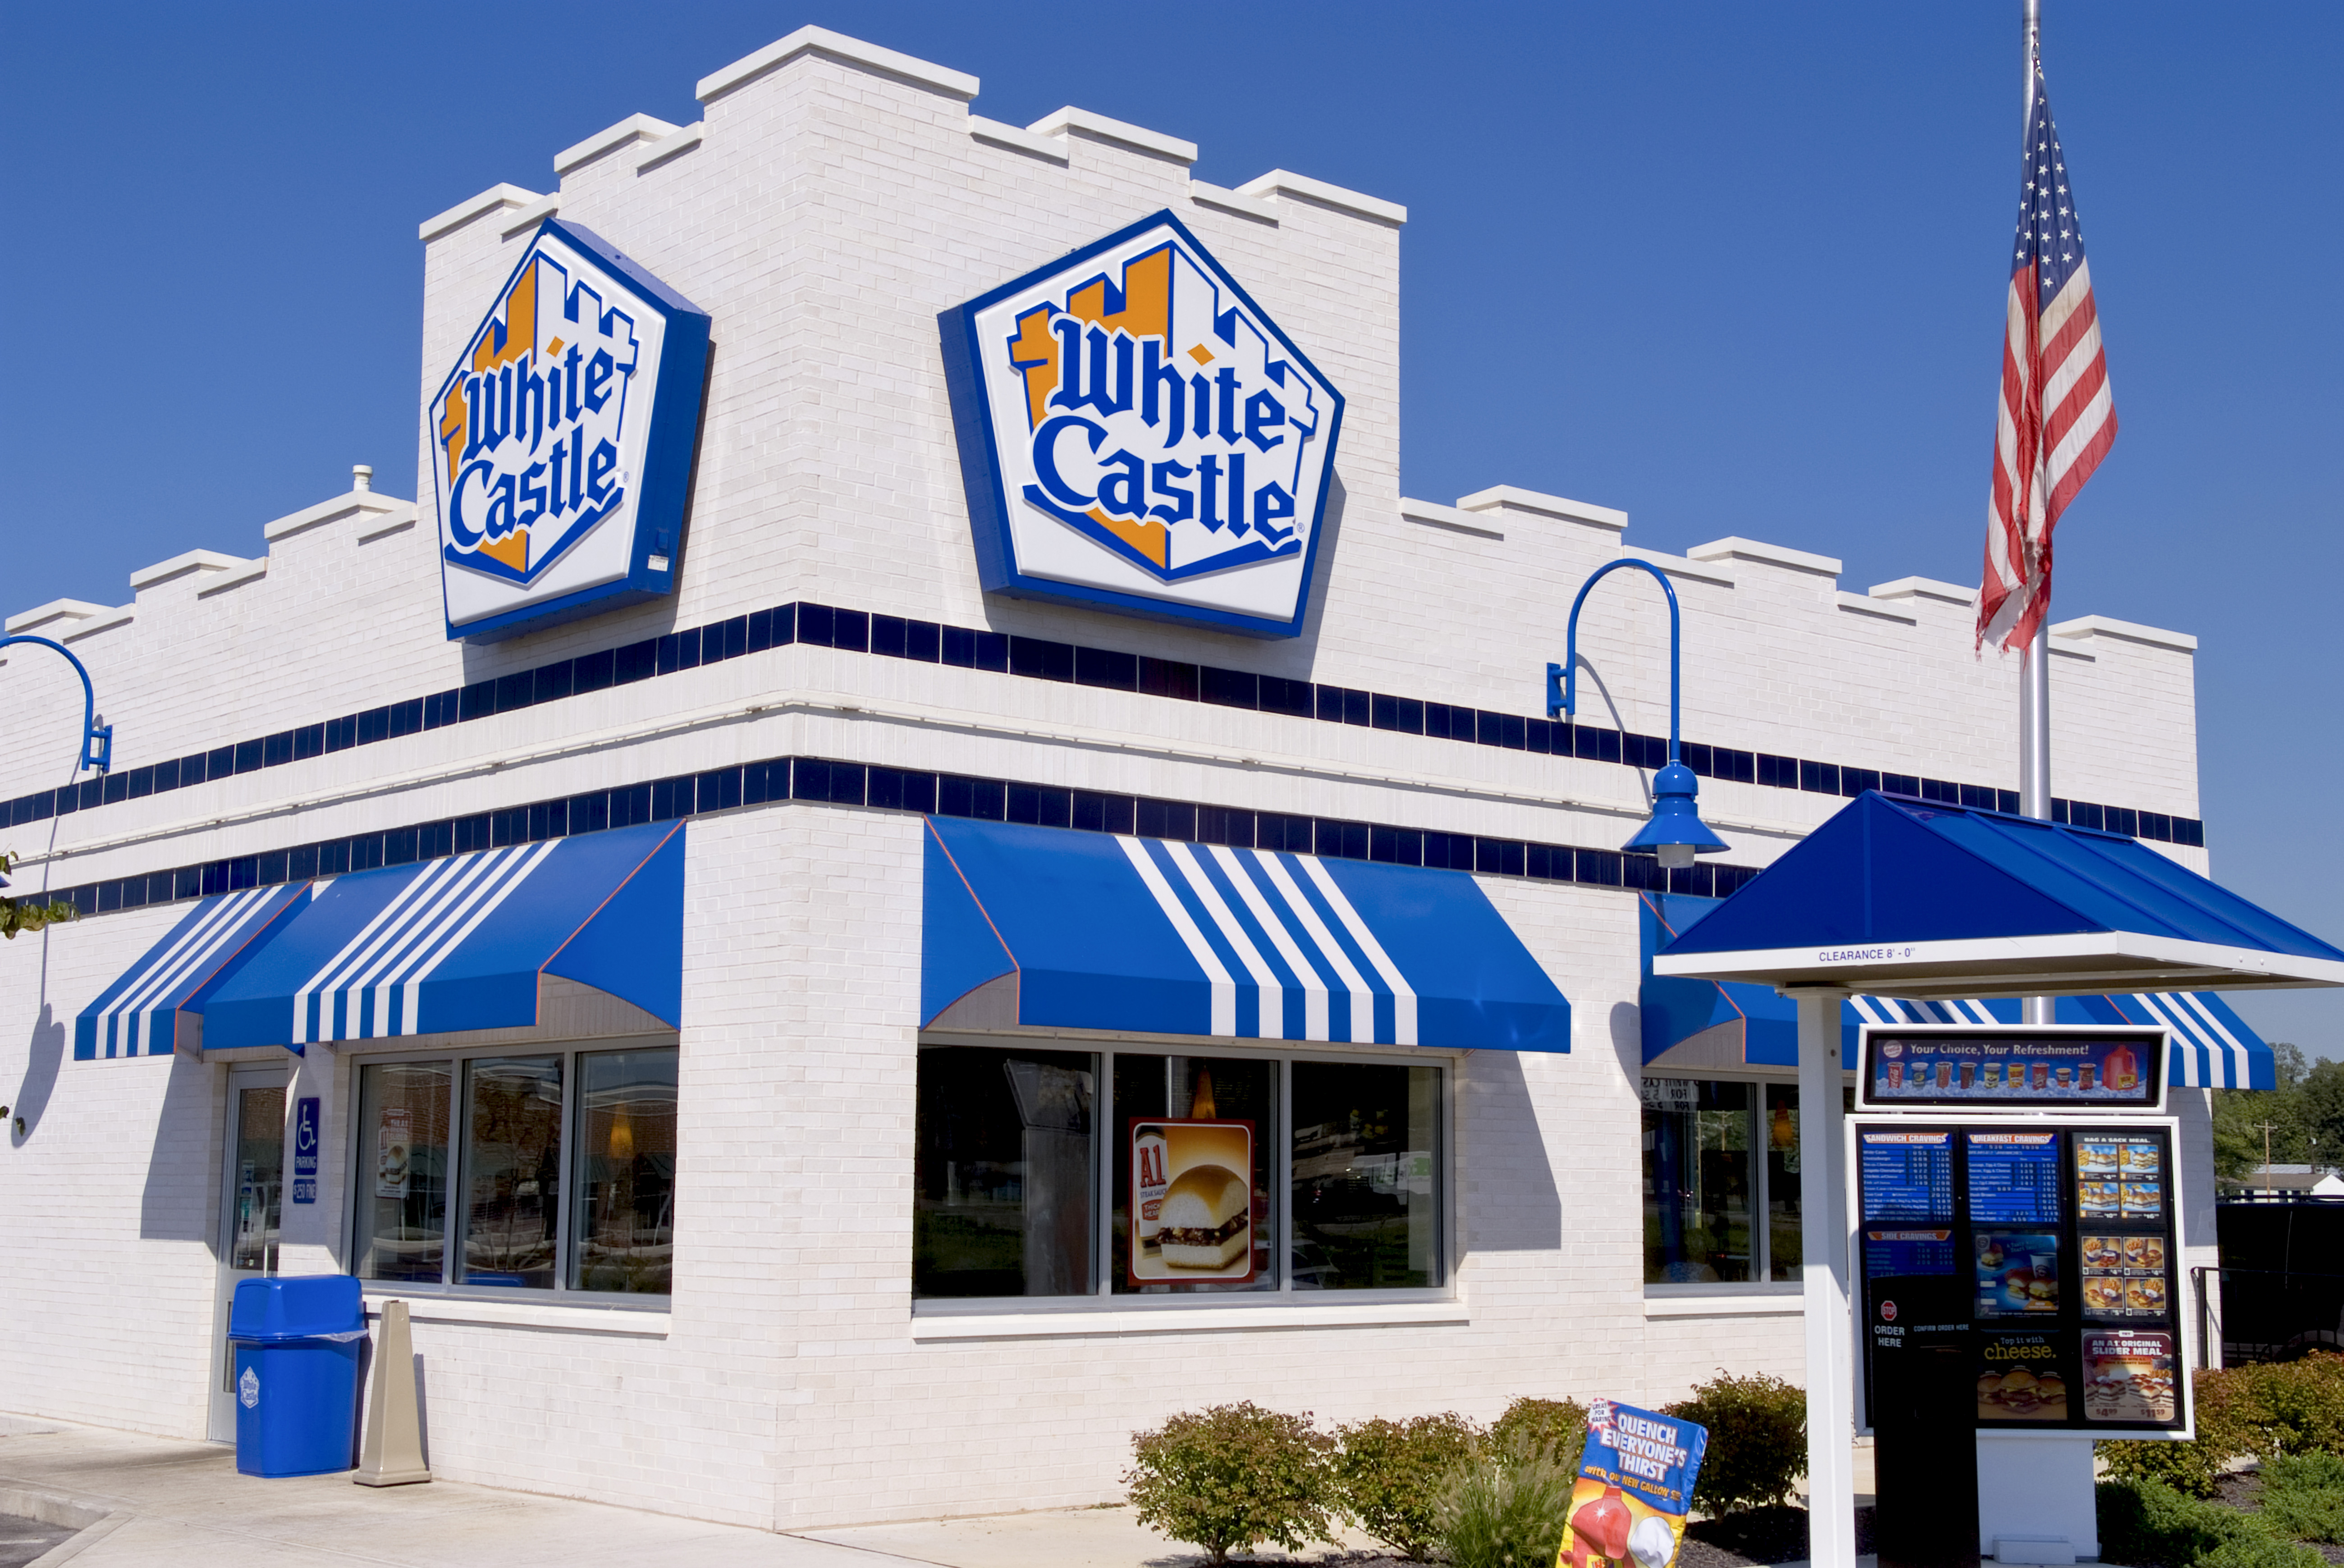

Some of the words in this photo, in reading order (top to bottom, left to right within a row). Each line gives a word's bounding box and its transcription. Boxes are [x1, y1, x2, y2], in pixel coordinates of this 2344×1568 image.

[1050, 318, 1285, 453] White
[460, 336, 613, 466] White
[450, 422, 616, 542] Castle
[1033, 415, 1295, 545] Castle
[1819, 949, 1883, 961] CLEARANCE
[1910, 1044, 1936, 1054] Your
[1940, 1044, 1981, 1056] Choice,
[1983, 1044, 2009, 1055] Your
[2013, 1045, 2089, 1055] Refreshment!
[1909, 1134, 1946, 1143] CRAVINGS
[296, 1156, 316, 1169] PARKING
[306, 1184, 316, 1199] FINE
[1140, 1190, 1153, 1198] STEAK
[1882, 1306, 1895, 1315] STOP
[1874, 1325, 1905, 1336] ORDER
[1877, 1337, 1902, 1348] HERE
[2000, 1337, 2015, 1345] Top
[2025, 1335, 2045, 1344] with
[1984, 1342, 2057, 1360] cheese.
[2092, 1347, 2130, 1355] SLIDER
[1618, 1414, 1676, 1445] QUENCH
[1601, 1428, 1687, 1467] EVERYONE'S
[1618, 1452, 1667, 1481] THIRST
[1584, 1465, 1607, 1477] with
[1622, 1475, 1639, 1489] NEW
[1640, 1481, 1670, 1497] GALLON
